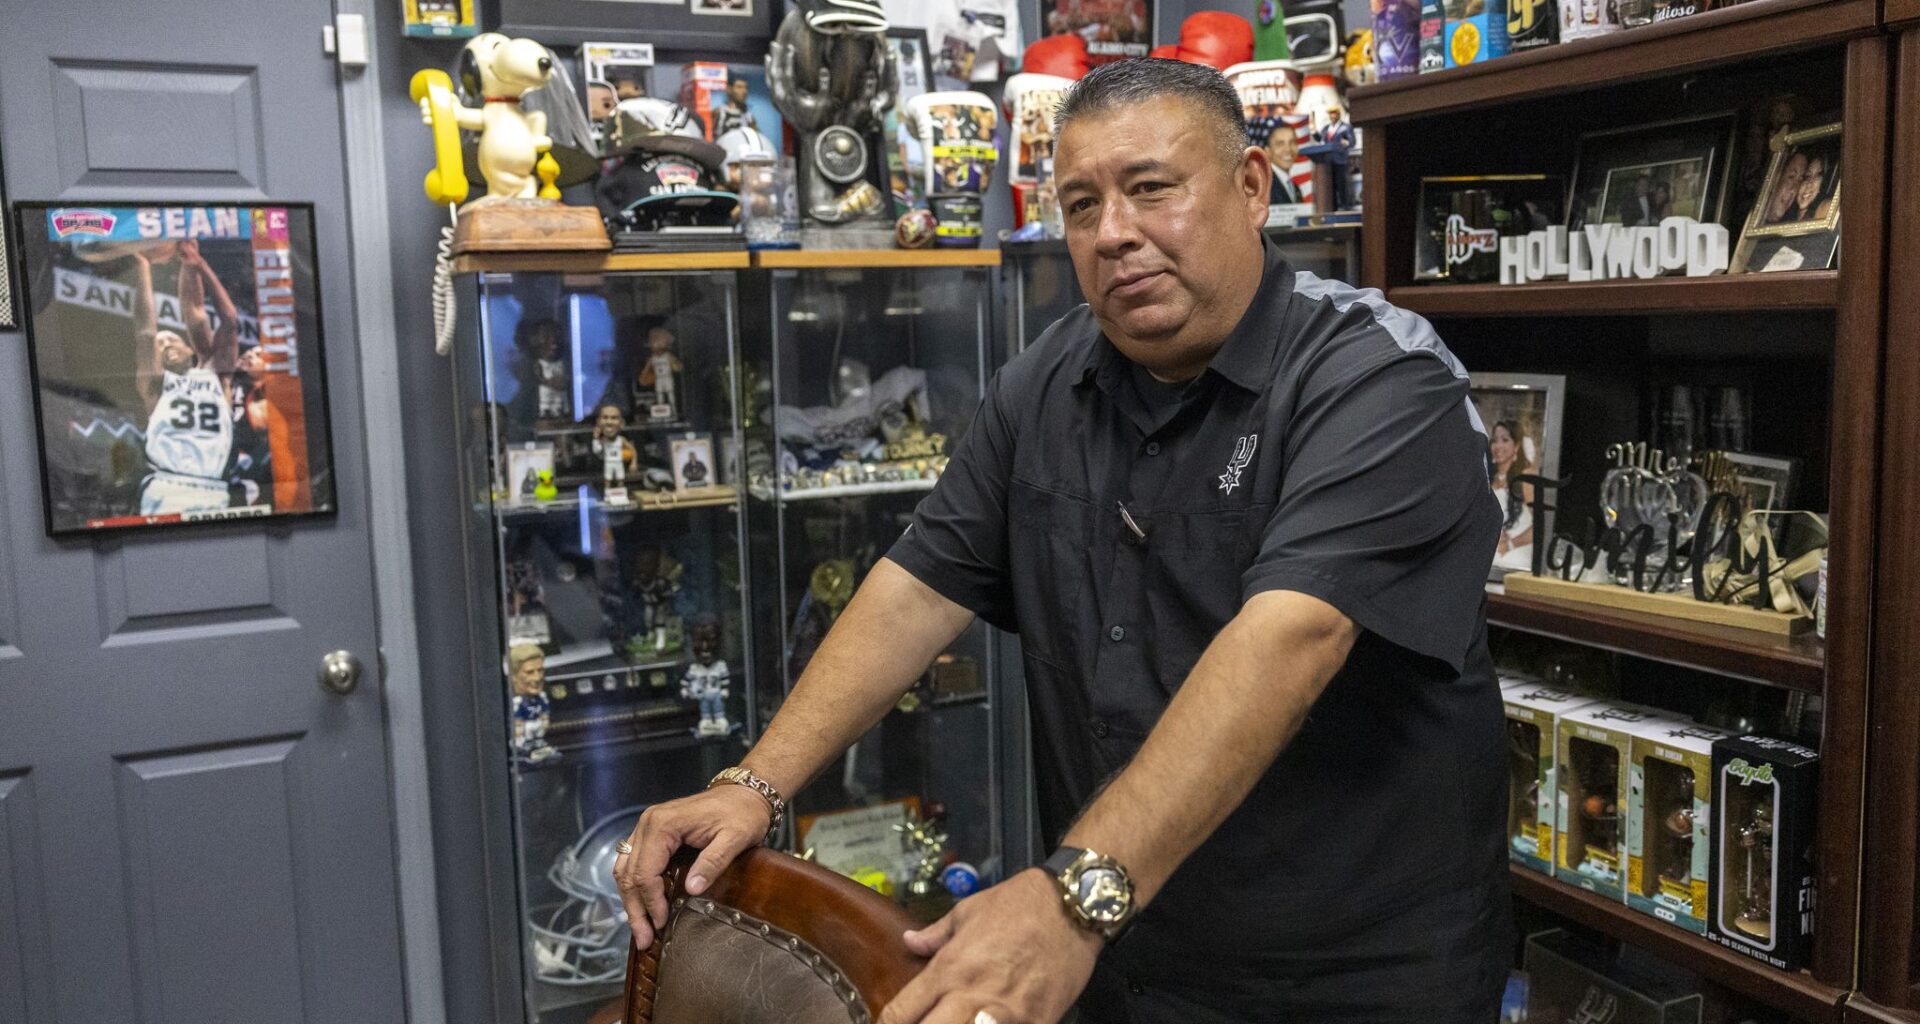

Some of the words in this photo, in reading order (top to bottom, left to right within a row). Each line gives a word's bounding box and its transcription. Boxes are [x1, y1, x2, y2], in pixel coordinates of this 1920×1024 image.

[137, 208, 240, 239] SEAN
[1500, 216, 1729, 285] HOLLYWOOD
[61, 278, 132, 313] SAN
[255, 249, 299, 376] ELLIOTT
[170, 398, 220, 433] 32
[1511, 473, 1790, 610] Family
[1731, 941, 1751, 955] SEASON
[1751, 949, 1769, 962] FIESTA
[1769, 956, 1787, 969] NIGHT
